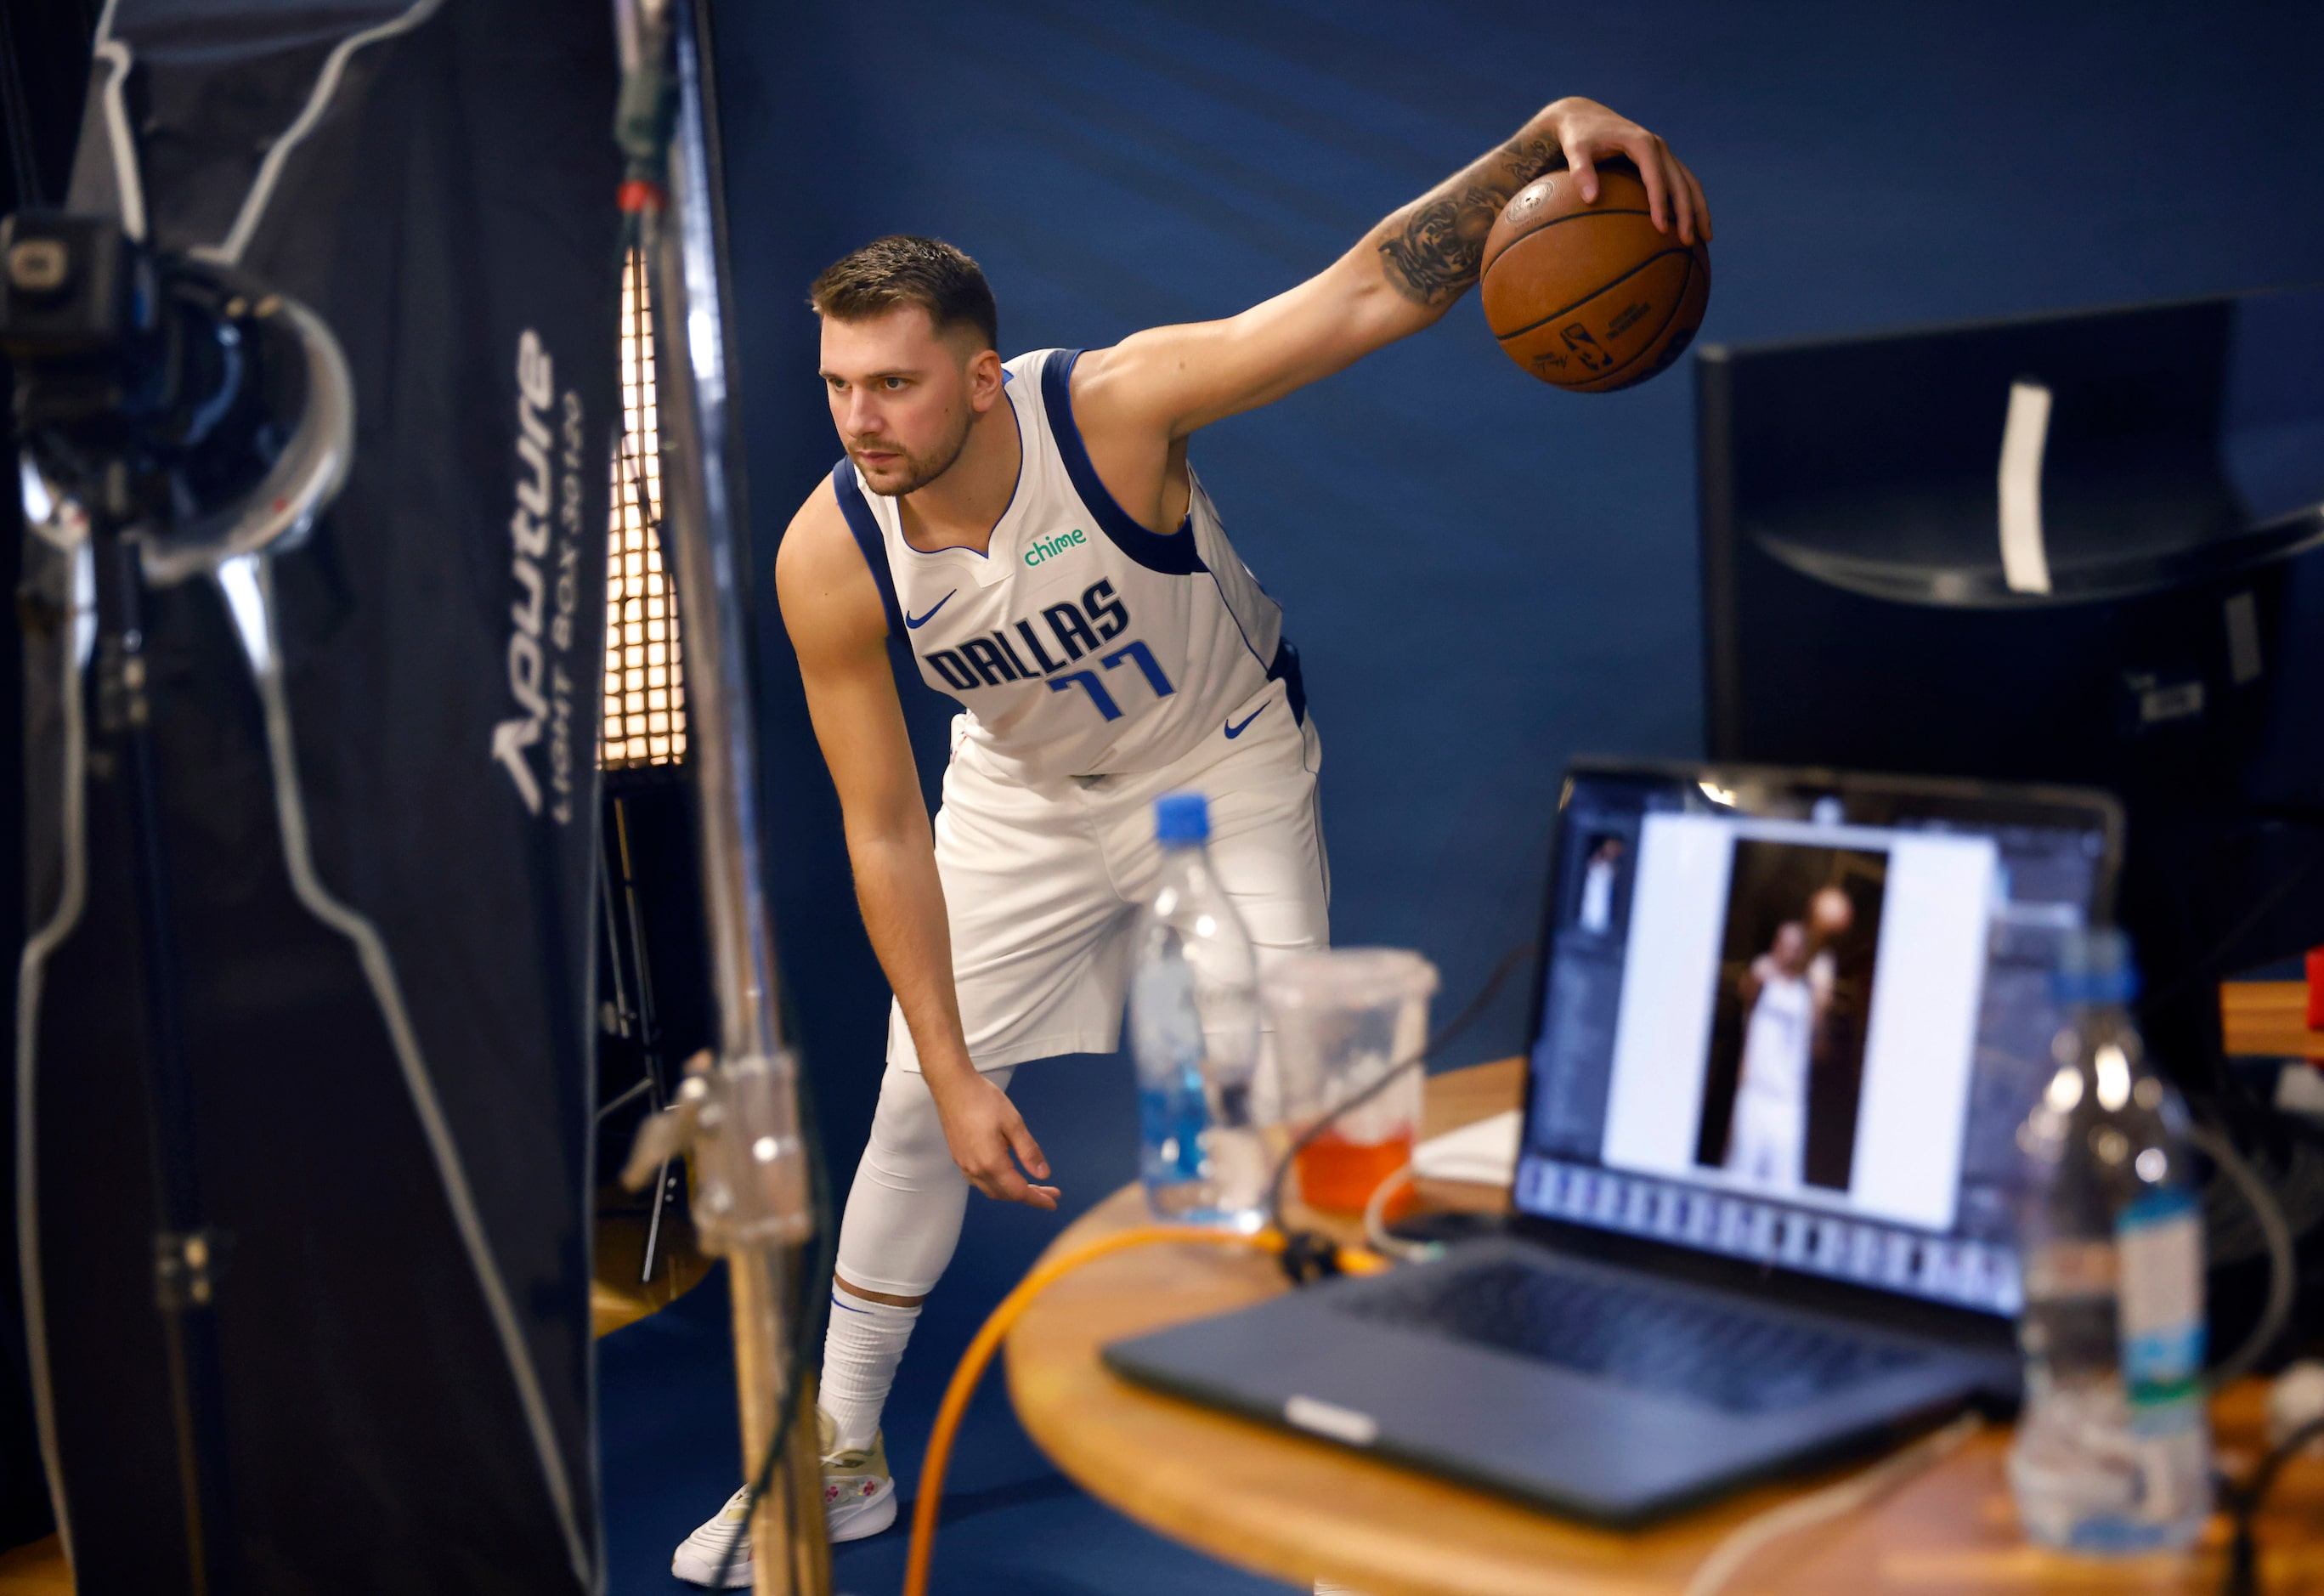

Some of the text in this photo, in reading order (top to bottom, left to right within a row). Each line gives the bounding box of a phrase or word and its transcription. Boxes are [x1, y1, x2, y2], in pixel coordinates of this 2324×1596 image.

[490, 328, 554, 816] Aputure
[551, 540, 581, 651] BOX
[1025, 529, 1087, 567] chime
[922, 576, 1130, 690] DALLAS
[1045, 639, 1176, 722] 77
[551, 665, 575, 824] LIGHT
